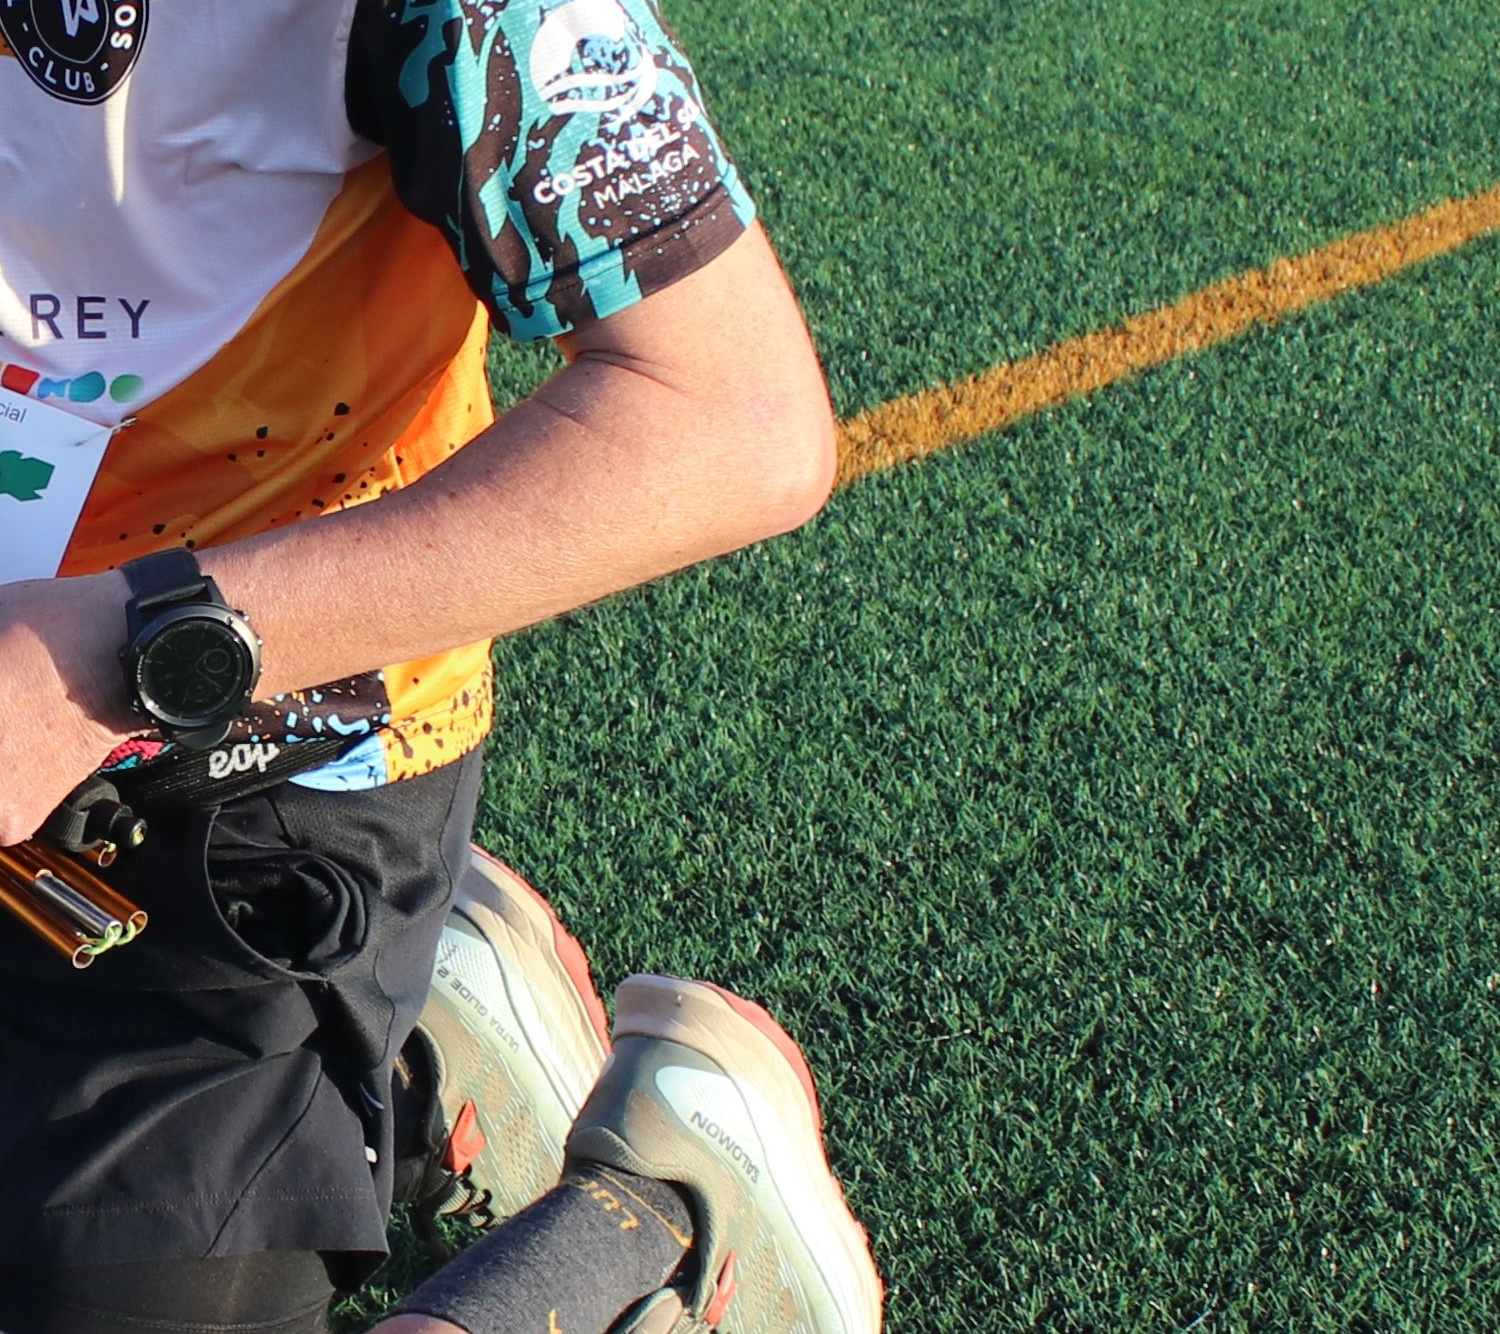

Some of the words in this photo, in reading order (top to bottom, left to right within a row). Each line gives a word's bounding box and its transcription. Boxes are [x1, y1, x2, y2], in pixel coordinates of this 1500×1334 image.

[28, 47, 95, 93] CLUB
[532, 142, 631, 204] COSTA
[29, 293, 151, 340] REY
[436, 966, 450, 979] 2
[449, 977, 489, 1017] GLIDE
[489, 1016, 520, 1054] ULTRA
[690, 1110, 761, 1185] SALOMON
